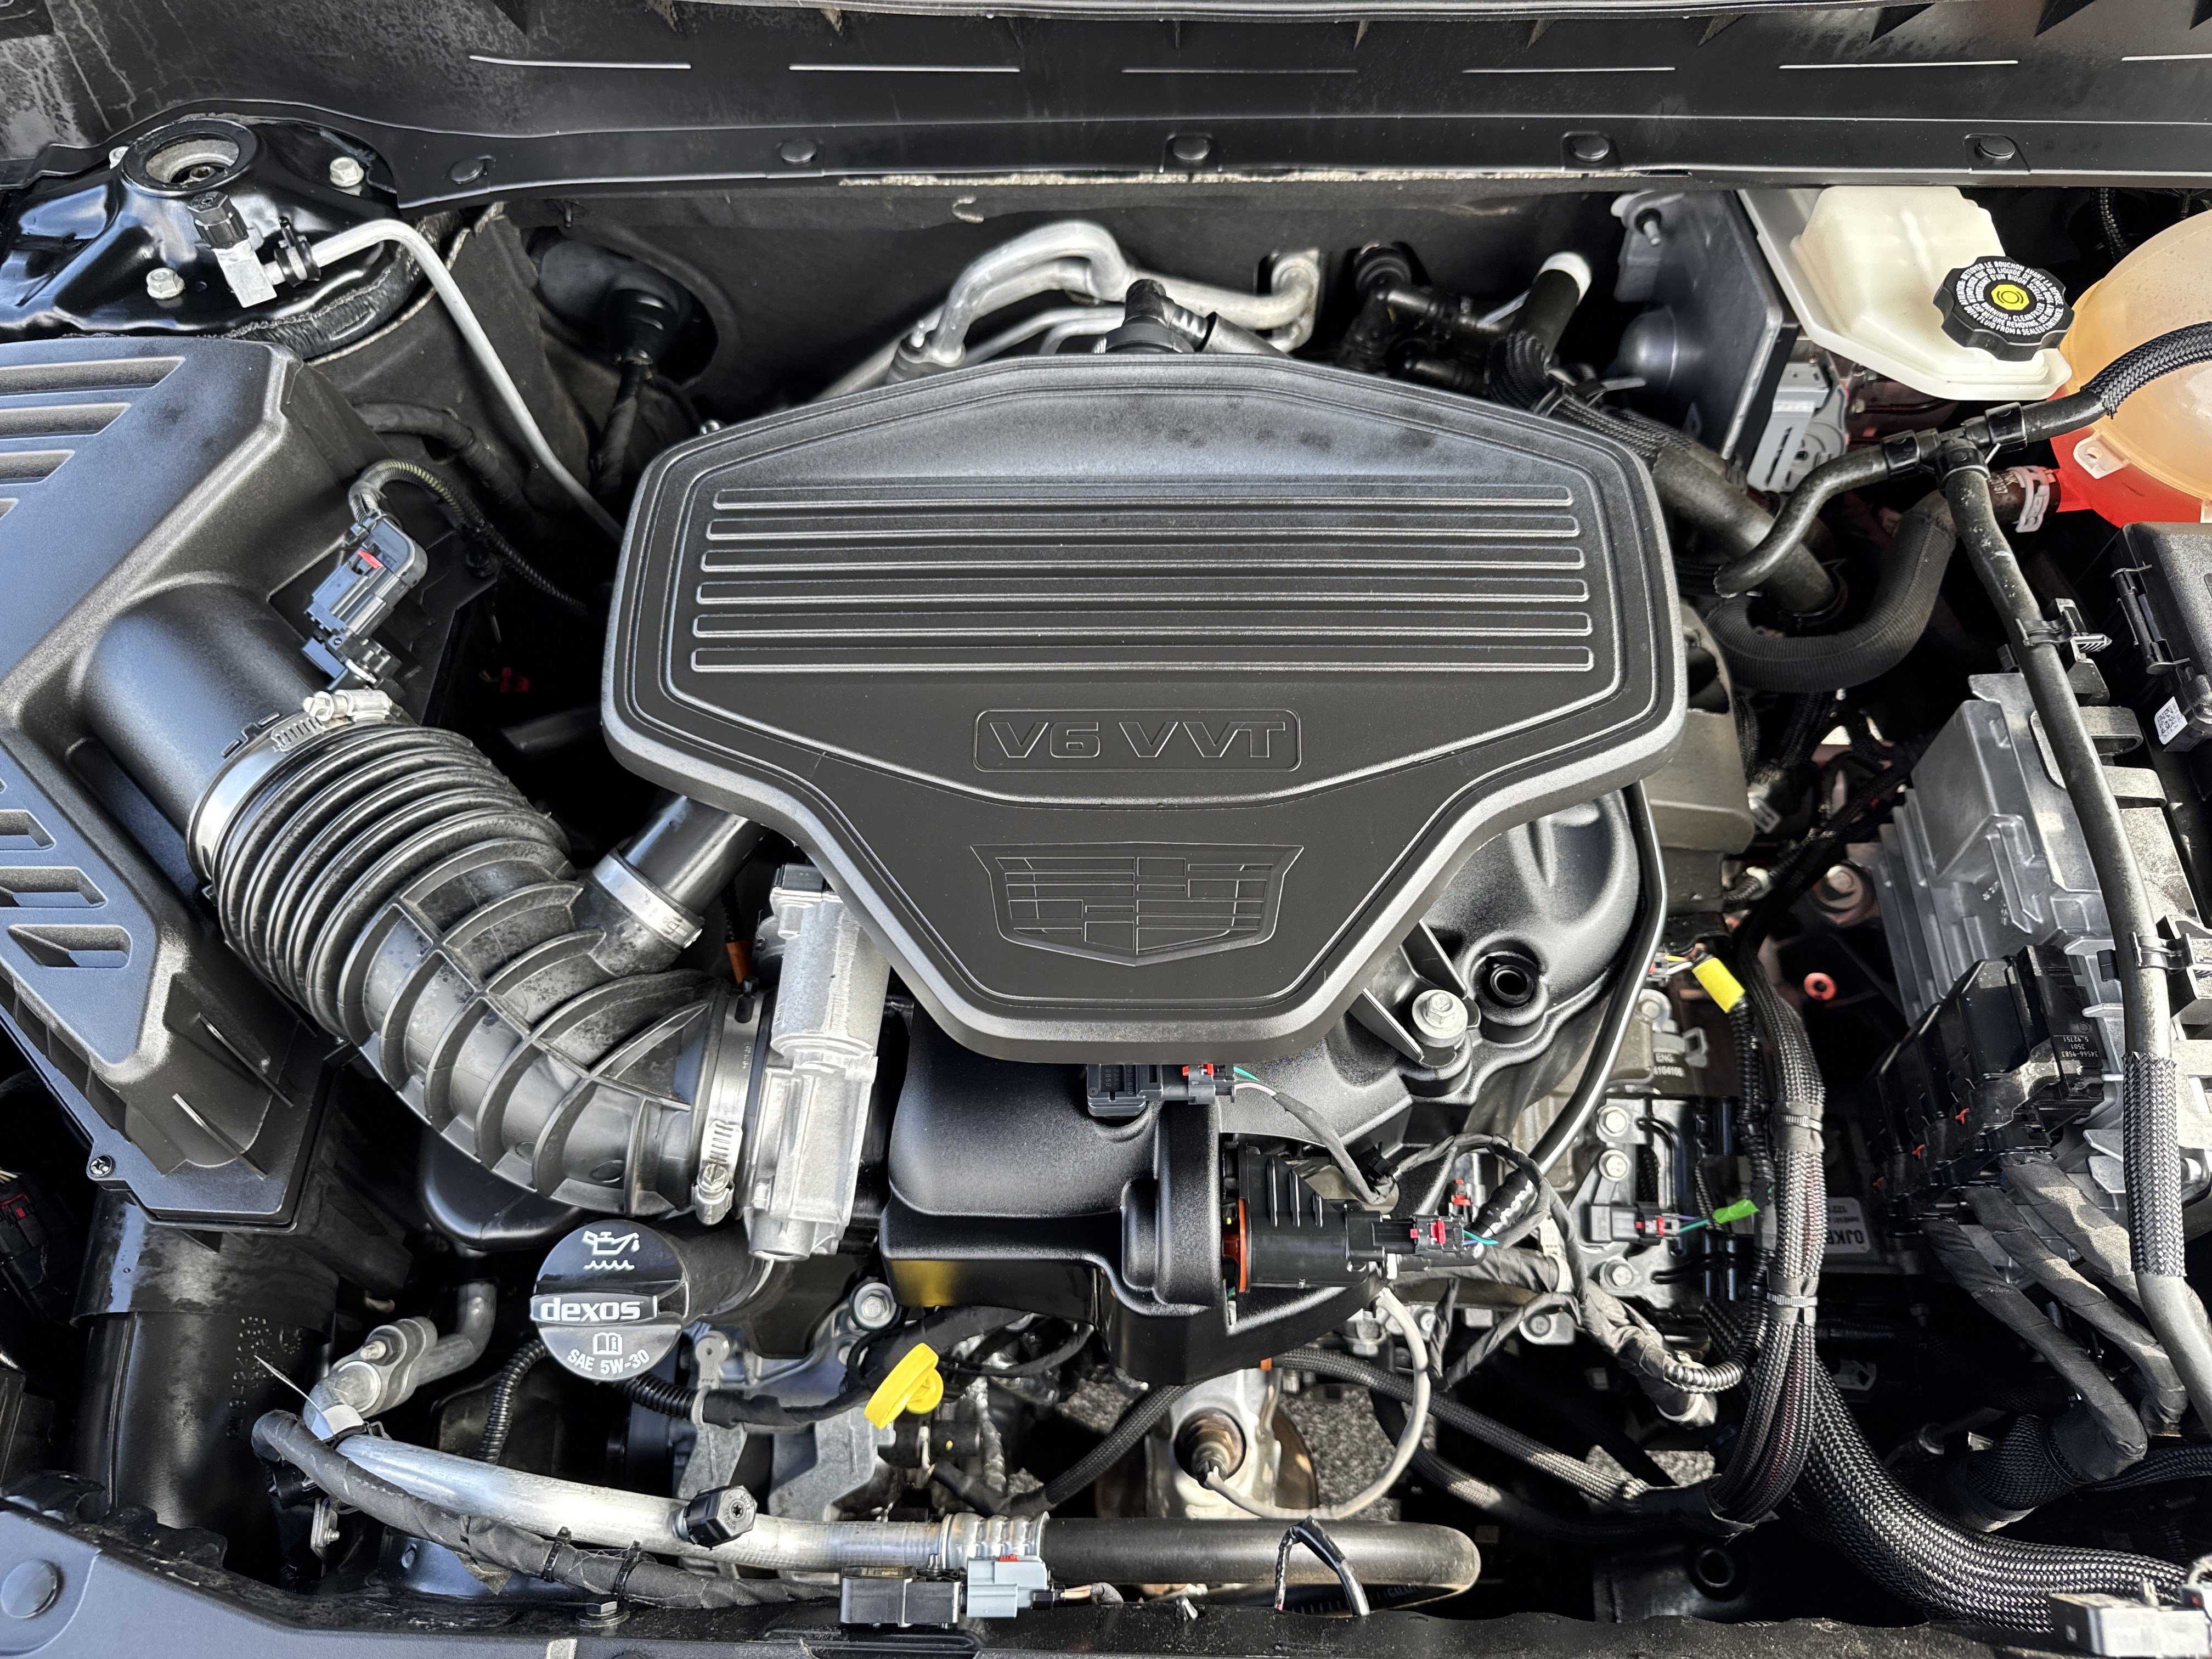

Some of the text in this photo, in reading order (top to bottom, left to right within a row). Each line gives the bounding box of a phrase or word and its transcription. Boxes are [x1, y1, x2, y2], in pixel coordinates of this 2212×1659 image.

[1975, 270, 1988, 279] QUE
[1997, 267, 2022, 276] LIQUIDE
[2030, 278, 2047, 291] FREIN
[1994, 261, 2024, 272] BOUCHON
[2024, 268, 2045, 280] AVANT
[2043, 279, 2052, 287] LA
[2007, 274, 2028, 285] BIDON
[2027, 283, 2045, 302] SCELLE
[1972, 303, 1984, 312] CAP
[1981, 311, 2006, 325] BEFORE
[1976, 315, 1996, 329] FLUID
[1996, 324, 2016, 335] FROM
[2021, 325, 2045, 336] SEALED
[990, 721, 1286, 758] V6 VVT
[540, 1297, 641, 1322] dexos
[567, 1348, 650, 1374] SAE 5W-30
